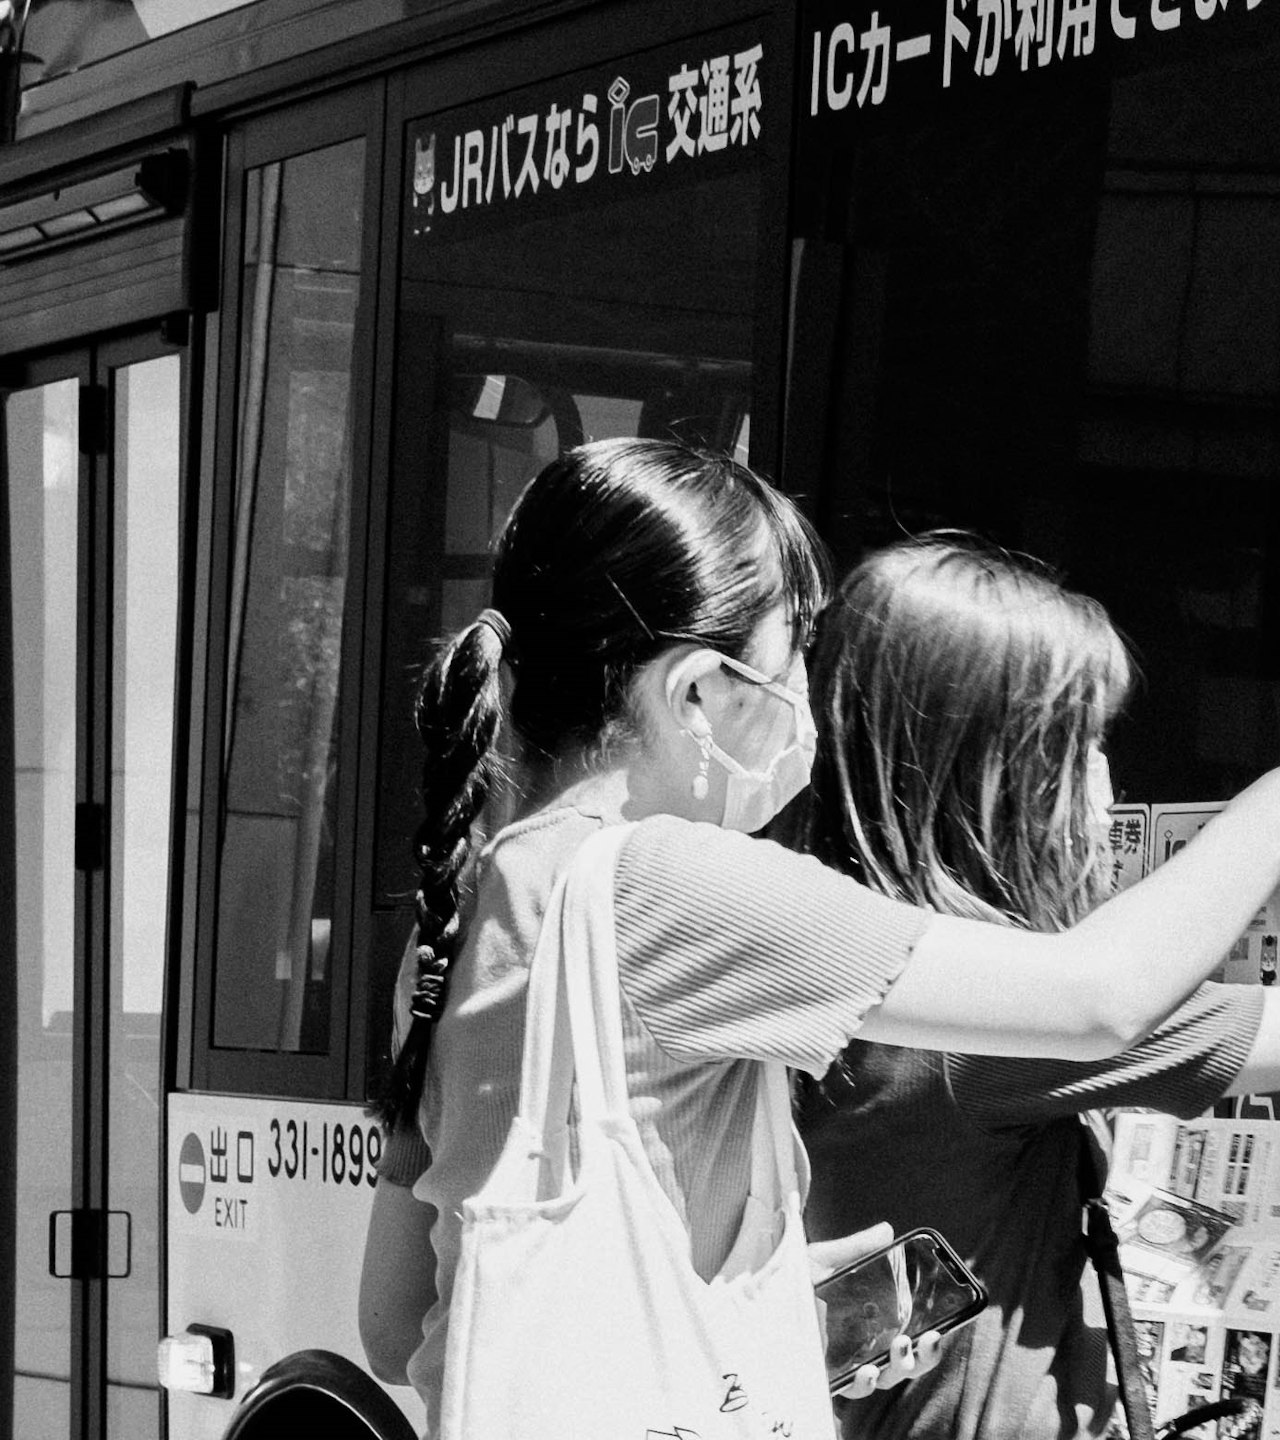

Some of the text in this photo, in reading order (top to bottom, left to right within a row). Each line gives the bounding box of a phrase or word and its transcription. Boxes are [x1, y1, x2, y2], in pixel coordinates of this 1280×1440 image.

[440, 93, 600, 216] JRバスなら
[666, 44, 764, 164] 交通系
[210, 1125, 254, 1183] 出口
[215, 1197, 248, 1229] EXIT
